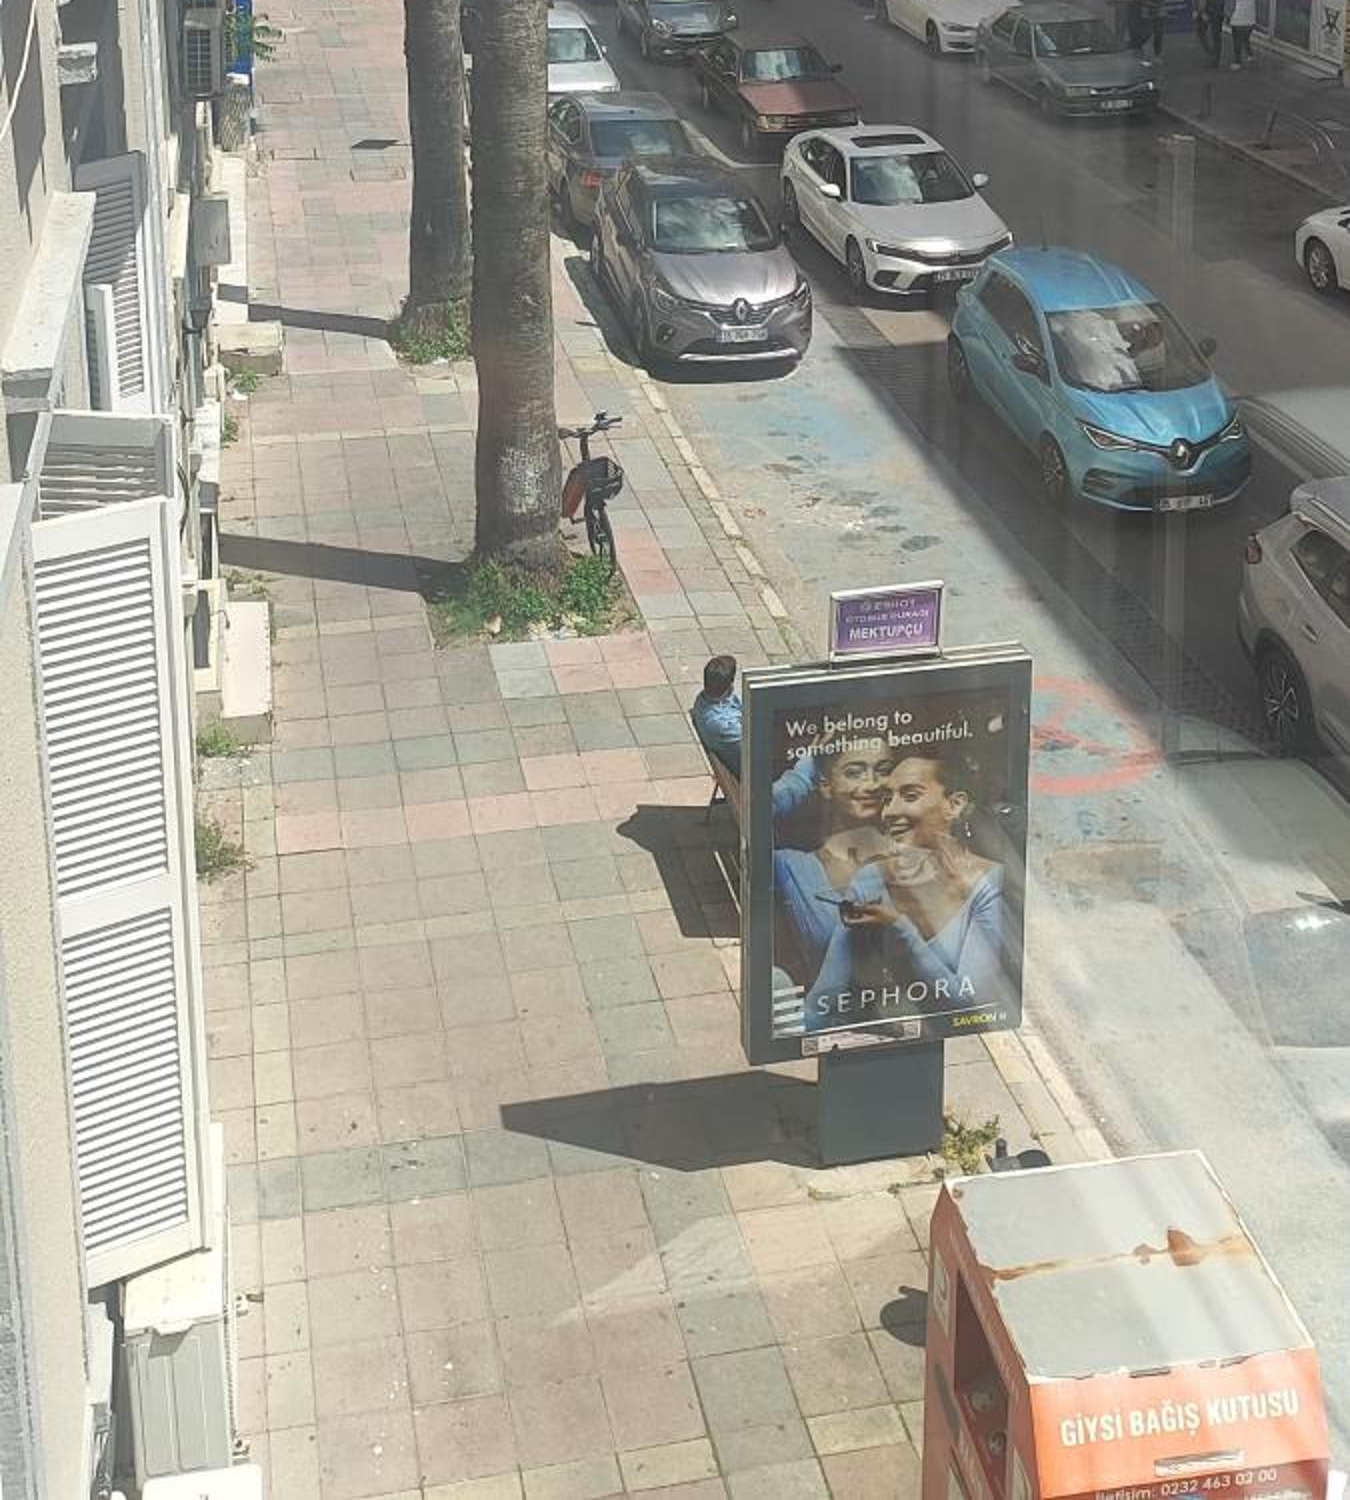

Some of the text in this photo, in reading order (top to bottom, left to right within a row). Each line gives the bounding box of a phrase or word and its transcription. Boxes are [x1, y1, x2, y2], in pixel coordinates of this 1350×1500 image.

[849, 623, 923, 641] MEKTUPÇU
[785, 710, 913, 738] We belong to
[786, 721, 974, 760] something beautiful.
[817, 976, 976, 1015] SEPHORA
[1060, 1388, 1300, 1447] GİYSİ BAĞIŞ KUTUSU
[1161, 1479, 1199, 1496] 0232
[1202, 1475, 1231, 1491] 463
[1258, 1467, 1278, 1482] 00
